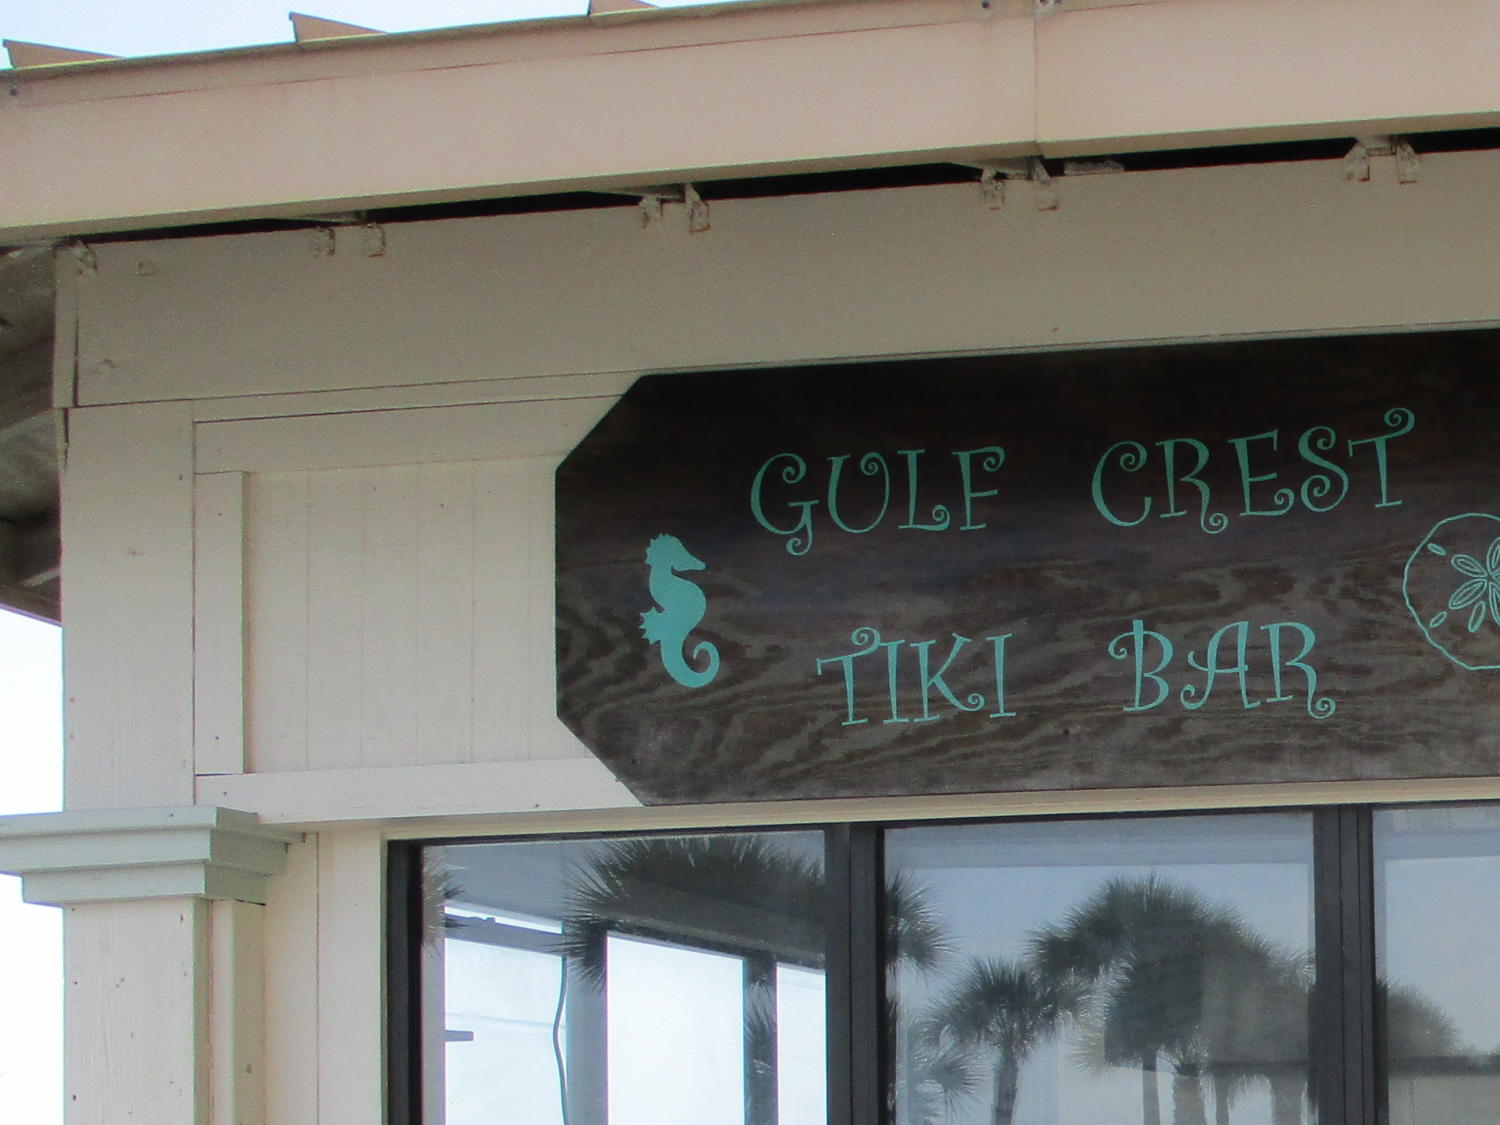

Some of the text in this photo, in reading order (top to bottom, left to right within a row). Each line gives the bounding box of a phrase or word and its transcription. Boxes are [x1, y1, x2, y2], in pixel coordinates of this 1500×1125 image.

[750, 407, 1416, 556] GULF CREST
[816, 618, 1337, 727] TIKI BAR
